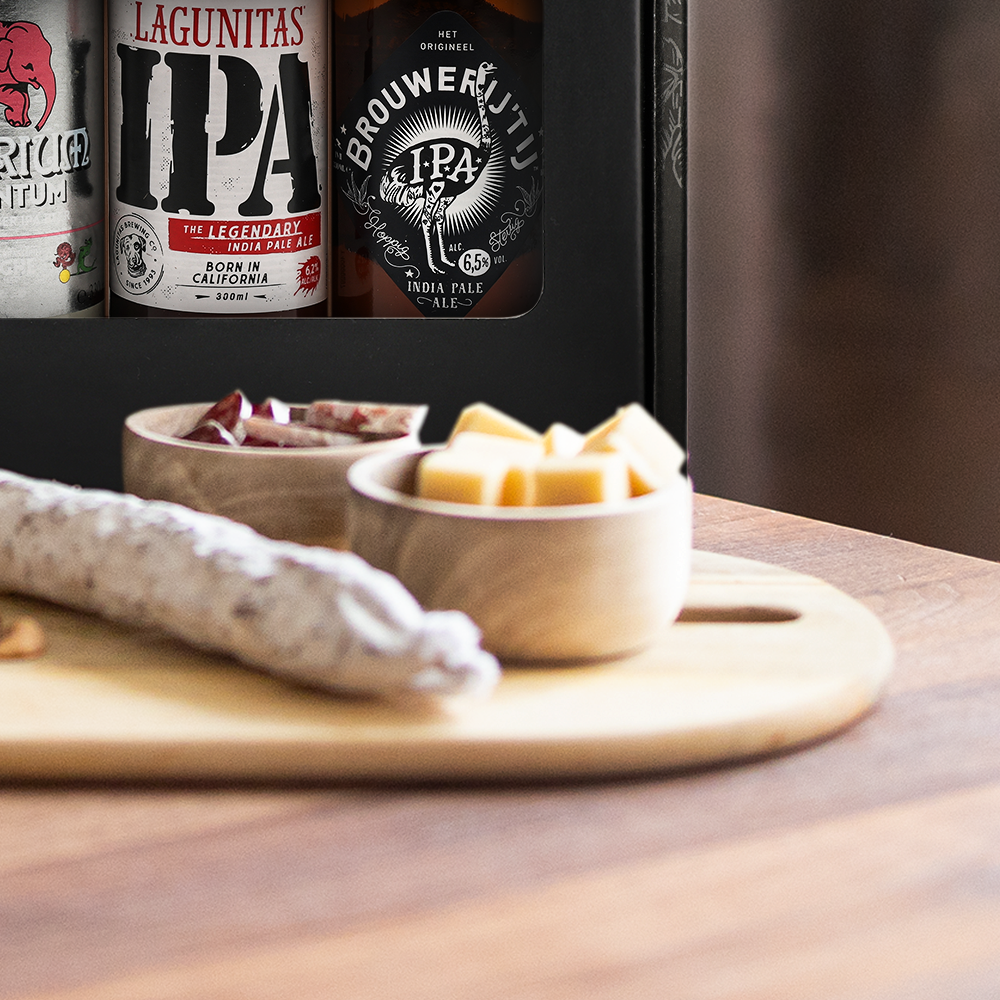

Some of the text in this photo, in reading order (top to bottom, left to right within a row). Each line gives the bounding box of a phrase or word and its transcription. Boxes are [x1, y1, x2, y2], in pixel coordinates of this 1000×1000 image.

[134, 1, 304, 48] LAGUNITAS
[438, 30, 458, 38] HET
[420, 42, 474, 51] ORIGINEEL
[116, 42, 322, 217] IPA
[410, 143, 478, 184] IPA
[124, 221, 151, 239] BREWING
[183, 221, 301, 239] THE LEGENDARY
[228, 234, 313, 252] INDIA PALE ALE
[448, 242, 465, 252] ALC.
[205, 261, 260, 272] BORN IN
[463, 253, 490, 273] 6,5%
[493, 256, 507, 265] VOL.
[125, 269, 157, 290] SINCE 1993
[192, 272, 268, 285] CALIFORNIA
[407, 281, 483, 294] INDIA PALE
[215, 292, 248, 301] 300ml
[432, 297, 459, 309] ALE
